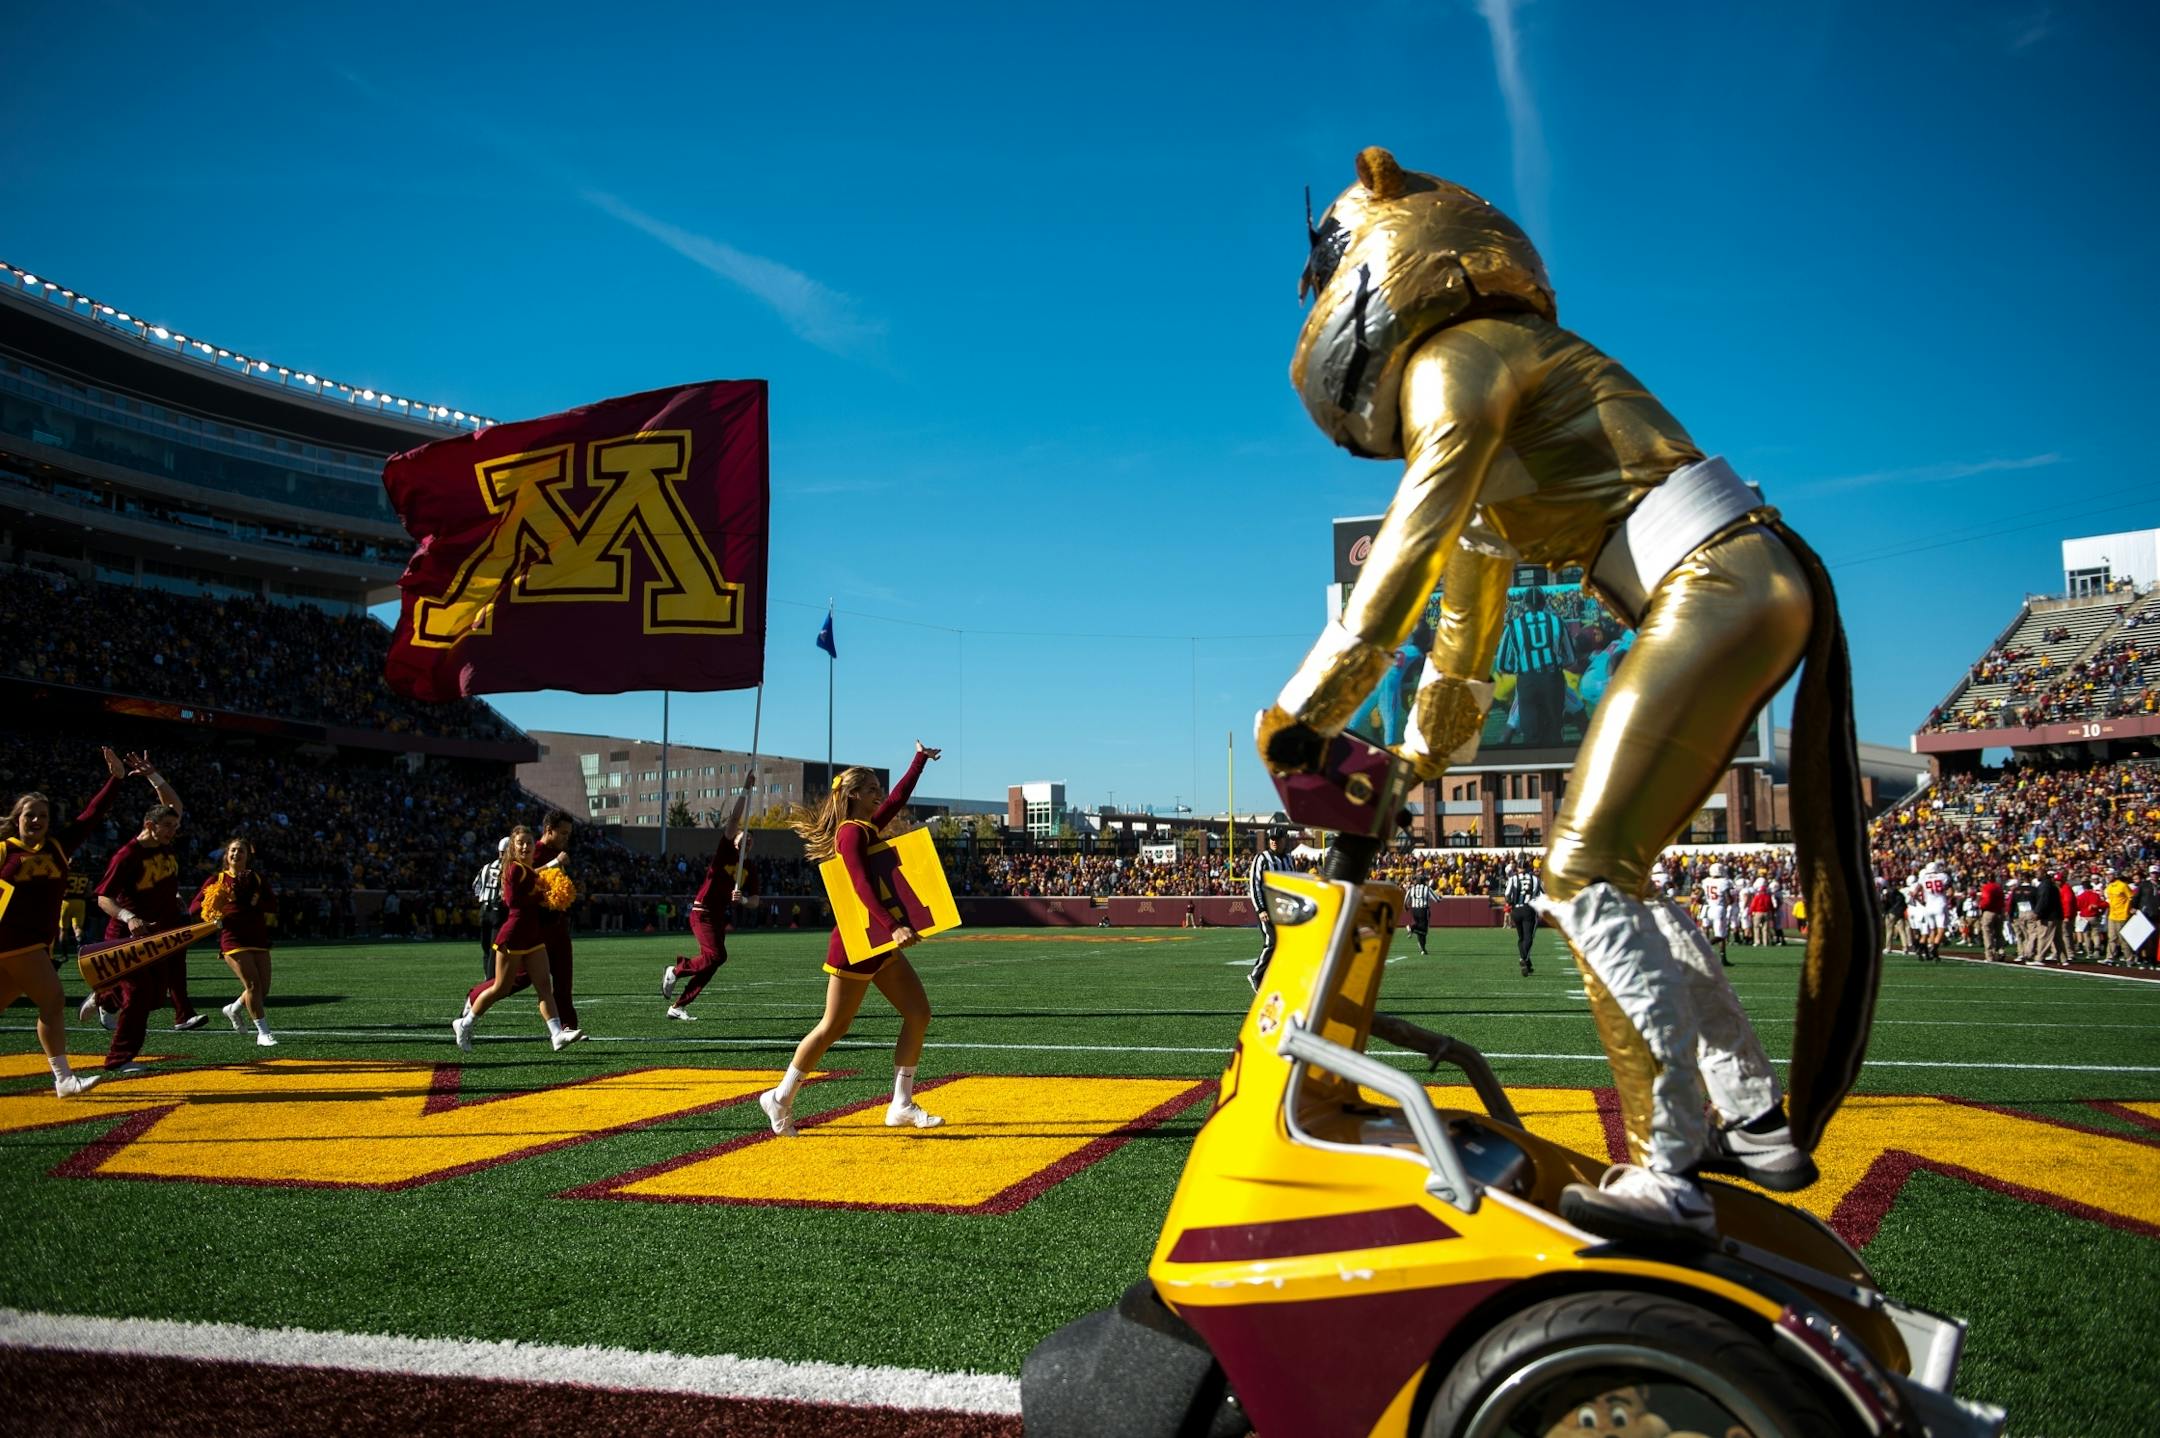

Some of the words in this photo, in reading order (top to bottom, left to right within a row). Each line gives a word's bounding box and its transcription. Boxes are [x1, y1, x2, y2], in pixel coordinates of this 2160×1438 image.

[410, 429, 745, 649] M
[1528, 623, 1547, 648] U
[2082, 723, 2101, 738] 10
[66, 877, 89, 894] 38
[1706, 885, 1718, 900] 15
[1925, 880, 1943, 893] 98
[90, 930, 194, 980] SKI-U-MAH
